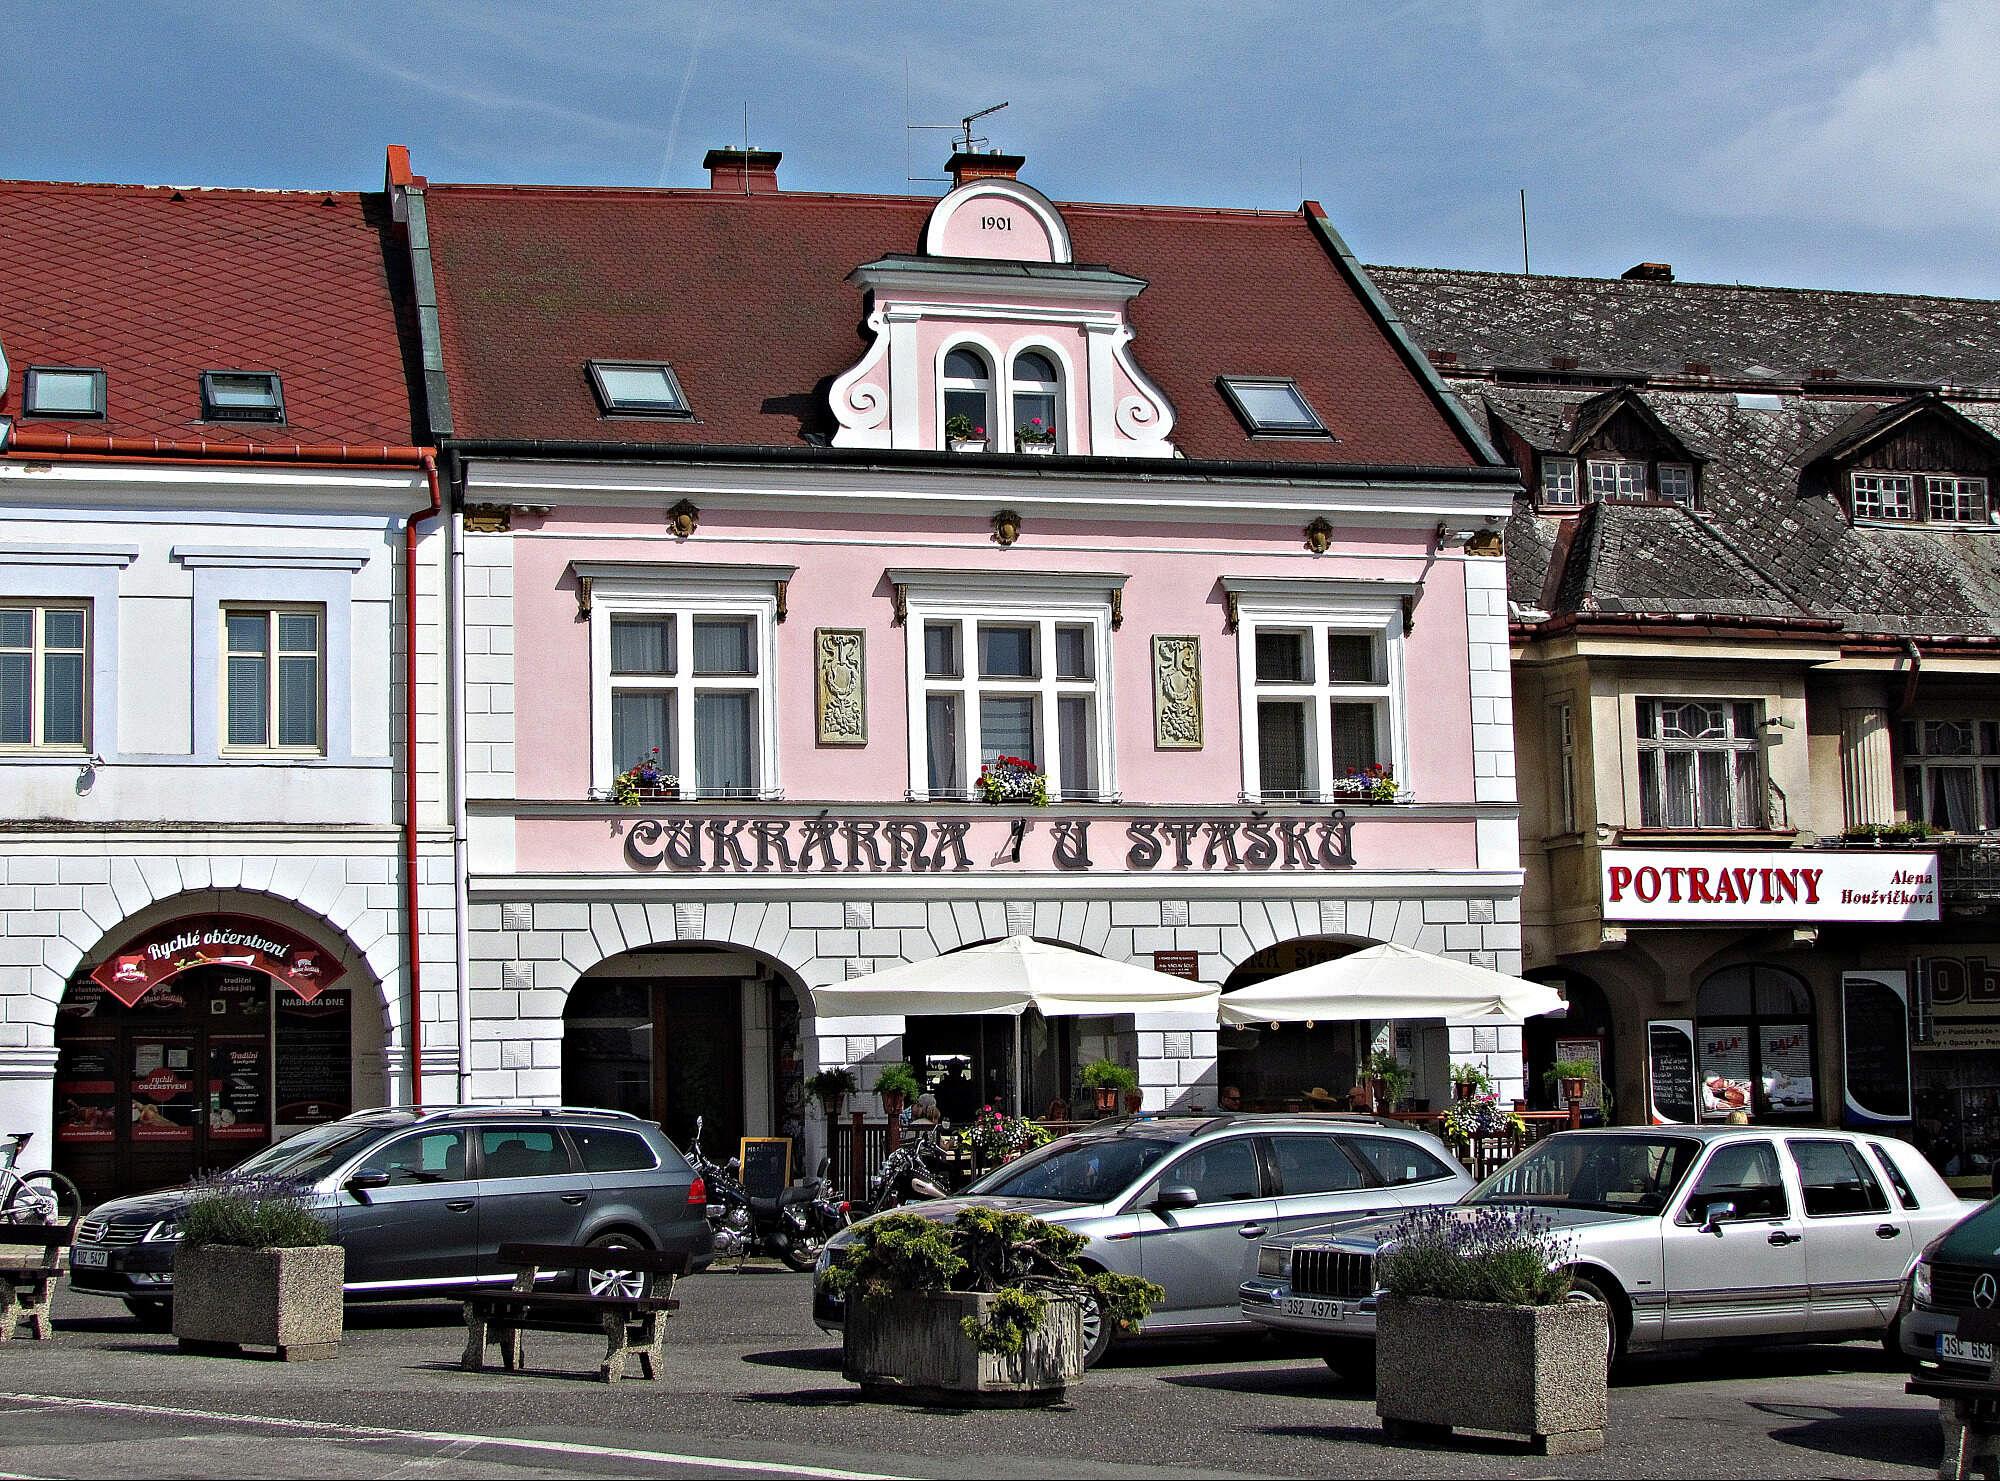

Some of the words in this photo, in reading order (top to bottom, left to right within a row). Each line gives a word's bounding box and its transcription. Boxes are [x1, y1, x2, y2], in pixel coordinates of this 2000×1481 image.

[981, 216, 1012, 231] 1901
[624, 809, 974, 869] CUKRÁRNA
[1053, 820, 1093, 868] U
[1129, 808, 1357, 868] STAŠKŮ
[1891, 869, 1932, 884] Alena
[1608, 866, 1823, 905] POTRAVINY
[1841, 889, 1933, 905] Houžvičková
[147, 928, 200, 961] Rychlé
[203, 928, 290, 958] občerstvení
[325, 998, 345, 1006] DNE
[1287, 1300, 1304, 1315] 3S2
[1311, 1301, 1338, 1317] 4978
[1944, 1337, 1964, 1355] 3SC
